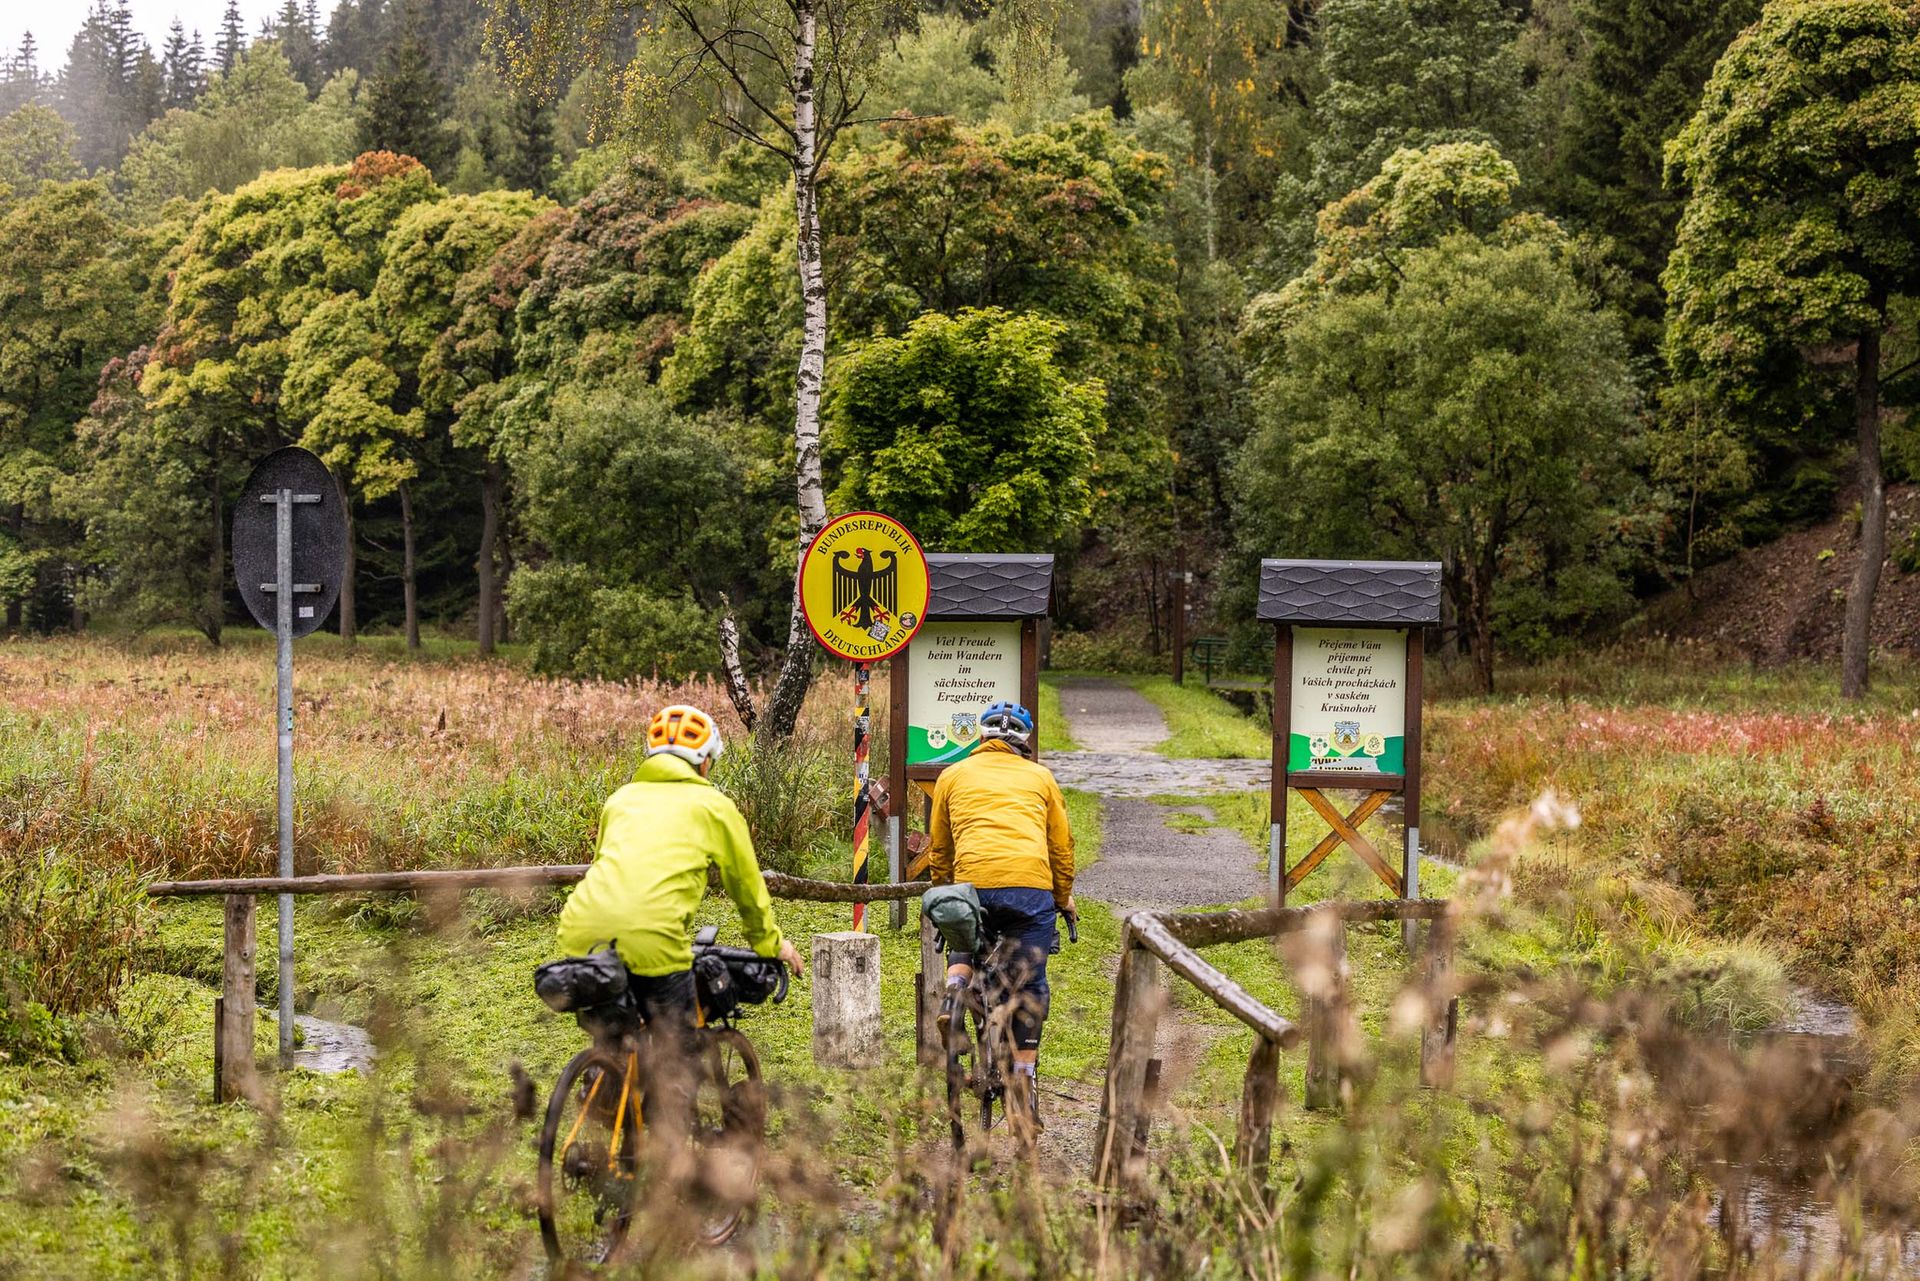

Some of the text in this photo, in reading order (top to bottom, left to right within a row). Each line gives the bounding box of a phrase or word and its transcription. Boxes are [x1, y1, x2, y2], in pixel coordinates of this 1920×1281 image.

[818, 520, 912, 555] BUNDESREPUBLIK
[823, 629, 906, 656] DEUTSCHLAND
[936, 636, 996, 647] Viel Freude
[1318, 639, 1381, 650] Přejeme Vám
[927, 650, 1002, 660] beim Wandern
[958, 664, 971, 674] im
[1357, 666, 1372, 676] při
[934, 678, 996, 688] sächsischen
[1302, 677, 1397, 689] Vašich procházkách
[937, 691, 994, 704] Erzgebirge
[1334, 691, 1370, 700] saském
[1320, 702, 1377, 713] Krušnohoří
